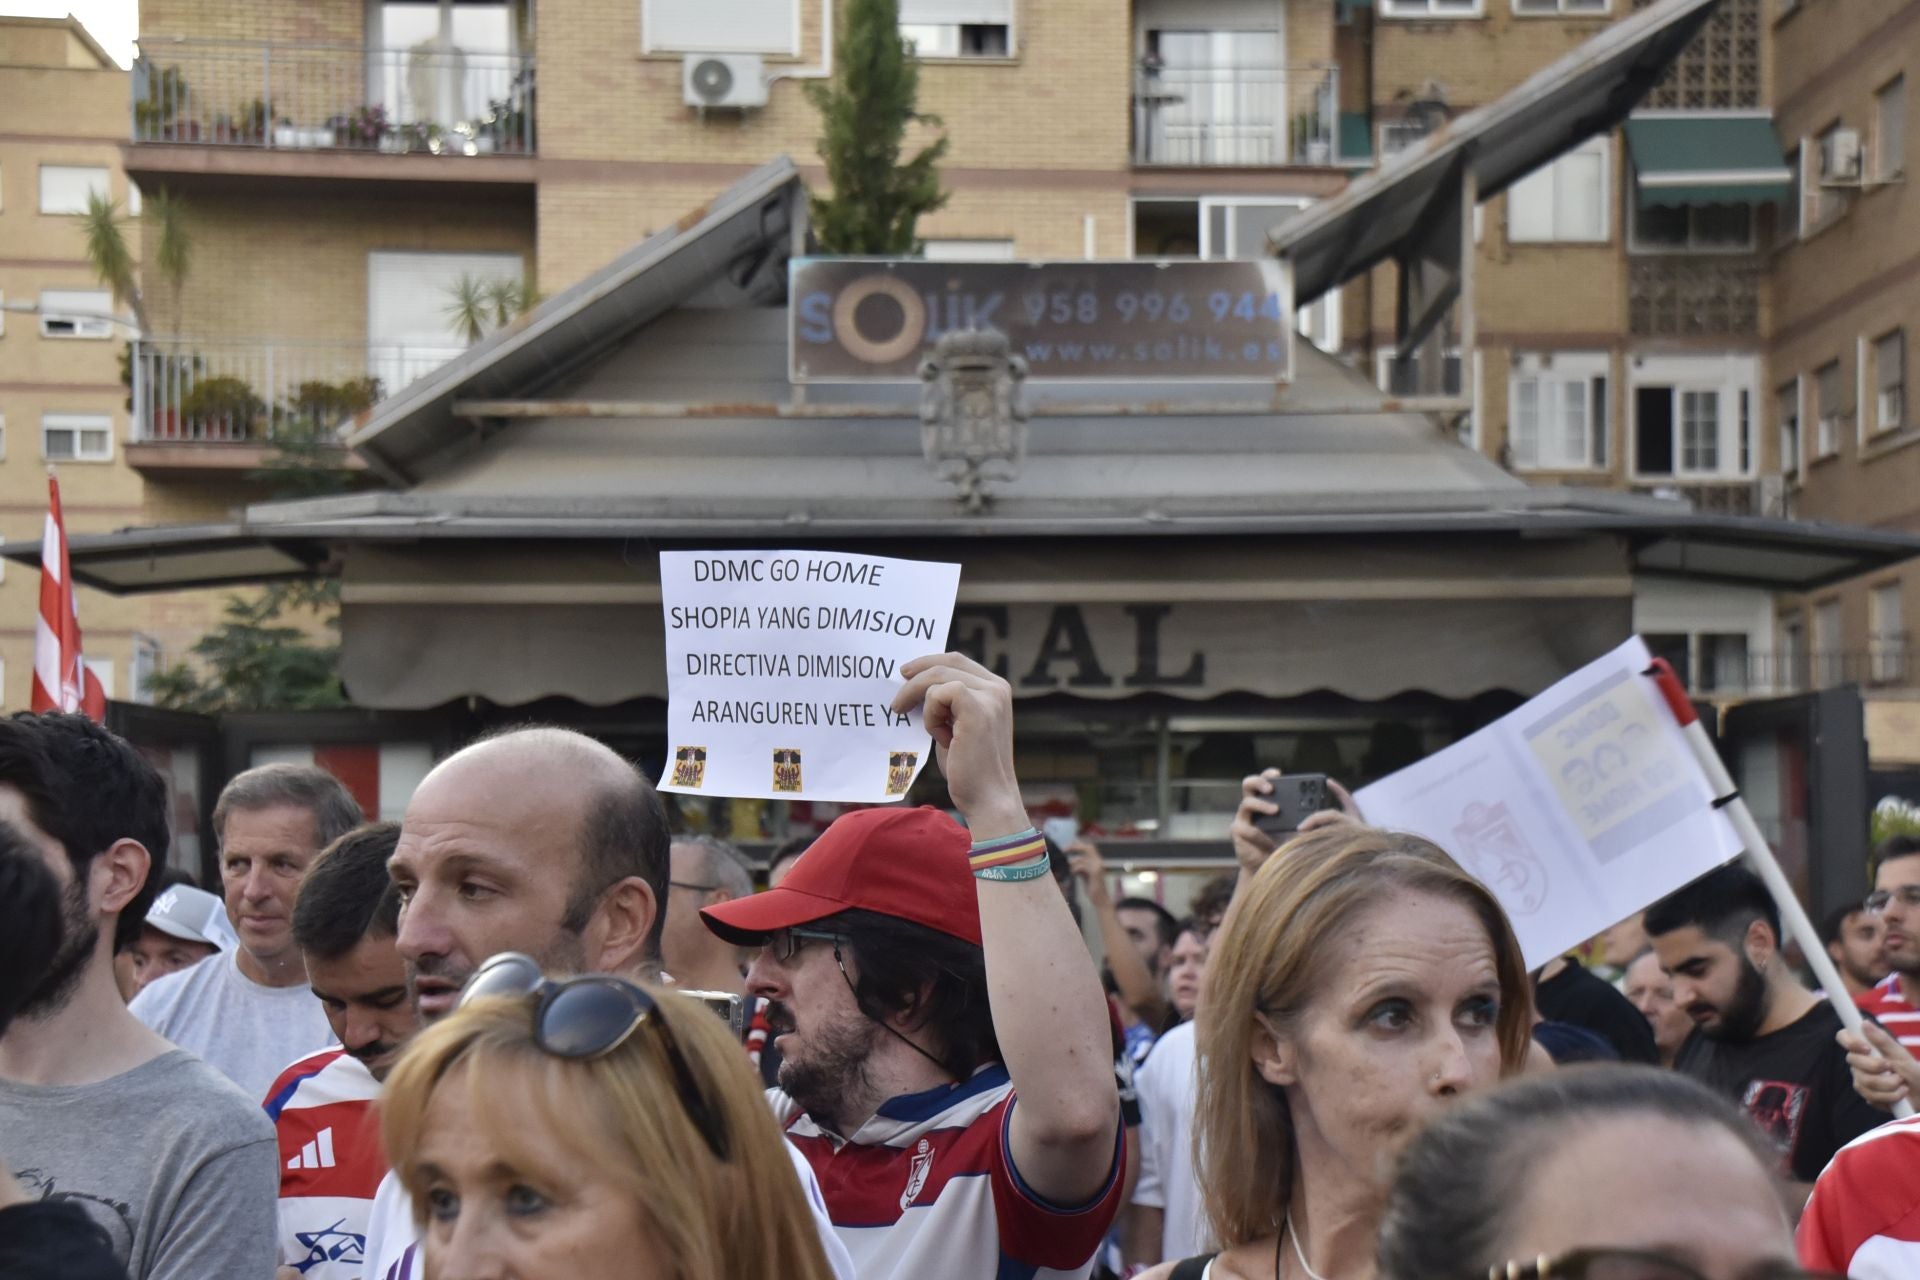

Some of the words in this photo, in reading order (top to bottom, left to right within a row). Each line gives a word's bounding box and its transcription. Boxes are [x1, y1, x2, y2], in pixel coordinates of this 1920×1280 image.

[1024, 291, 1098, 325] 958
[1116, 291, 1191, 323] 996
[1208, 291, 1281, 322] 944
[694, 559, 764, 582] DDMC
[770, 558, 800, 582] GO
[806, 559, 885, 586] HOME
[671, 606, 750, 629] SHOPIA
[757, 606, 811, 630] YANG
[817, 606, 935, 640] DIMISION
[687, 653, 791, 677] DIRECTIVA
[797, 654, 895, 679] DIMISION
[691, 700, 818, 726] ARANGUREN
[823, 703, 876, 727] VETE
[880, 703, 911, 727] YA
